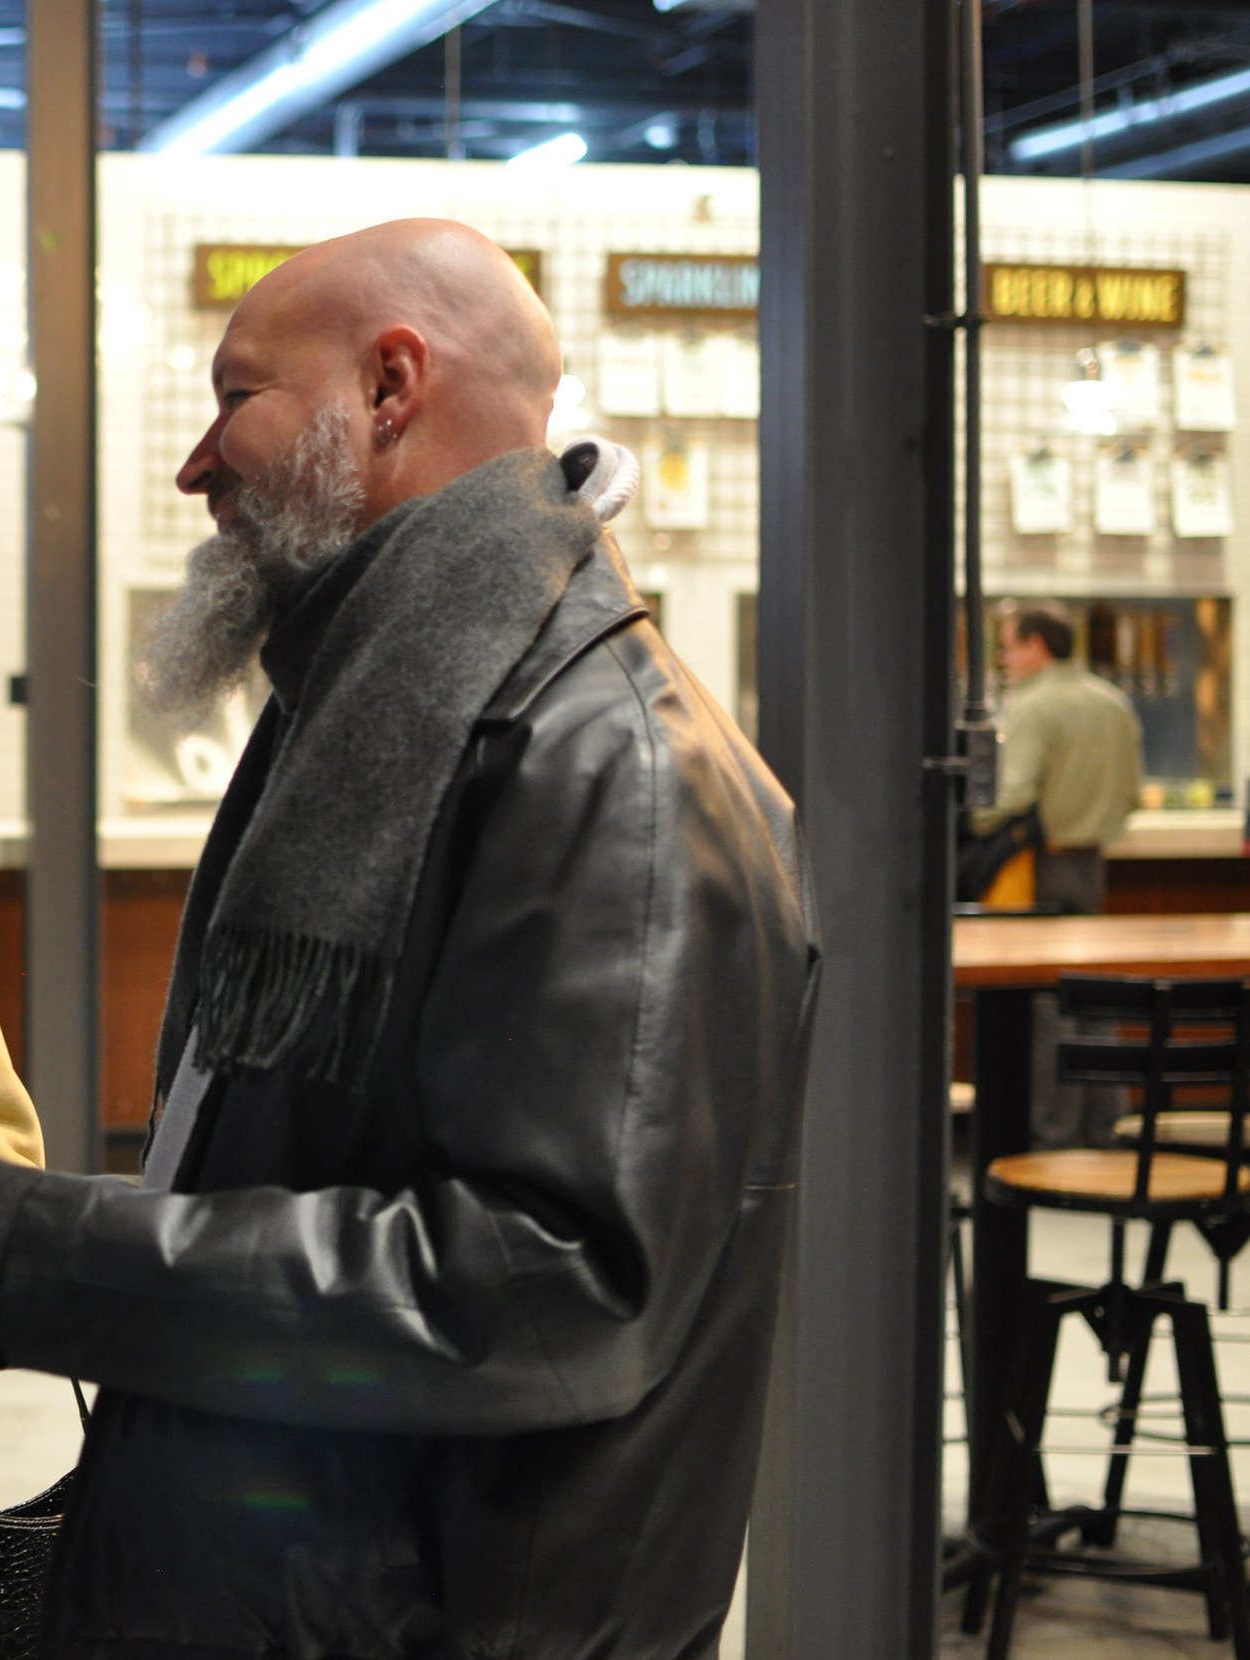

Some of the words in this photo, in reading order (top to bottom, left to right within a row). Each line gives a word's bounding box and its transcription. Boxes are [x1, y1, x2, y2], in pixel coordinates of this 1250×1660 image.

[620, 260, 760, 308] SPARKLIN
[992, 267, 1073, 318] BEER
[1074, 275, 1096, 319] &
[1096, 271, 1178, 322] WINE
